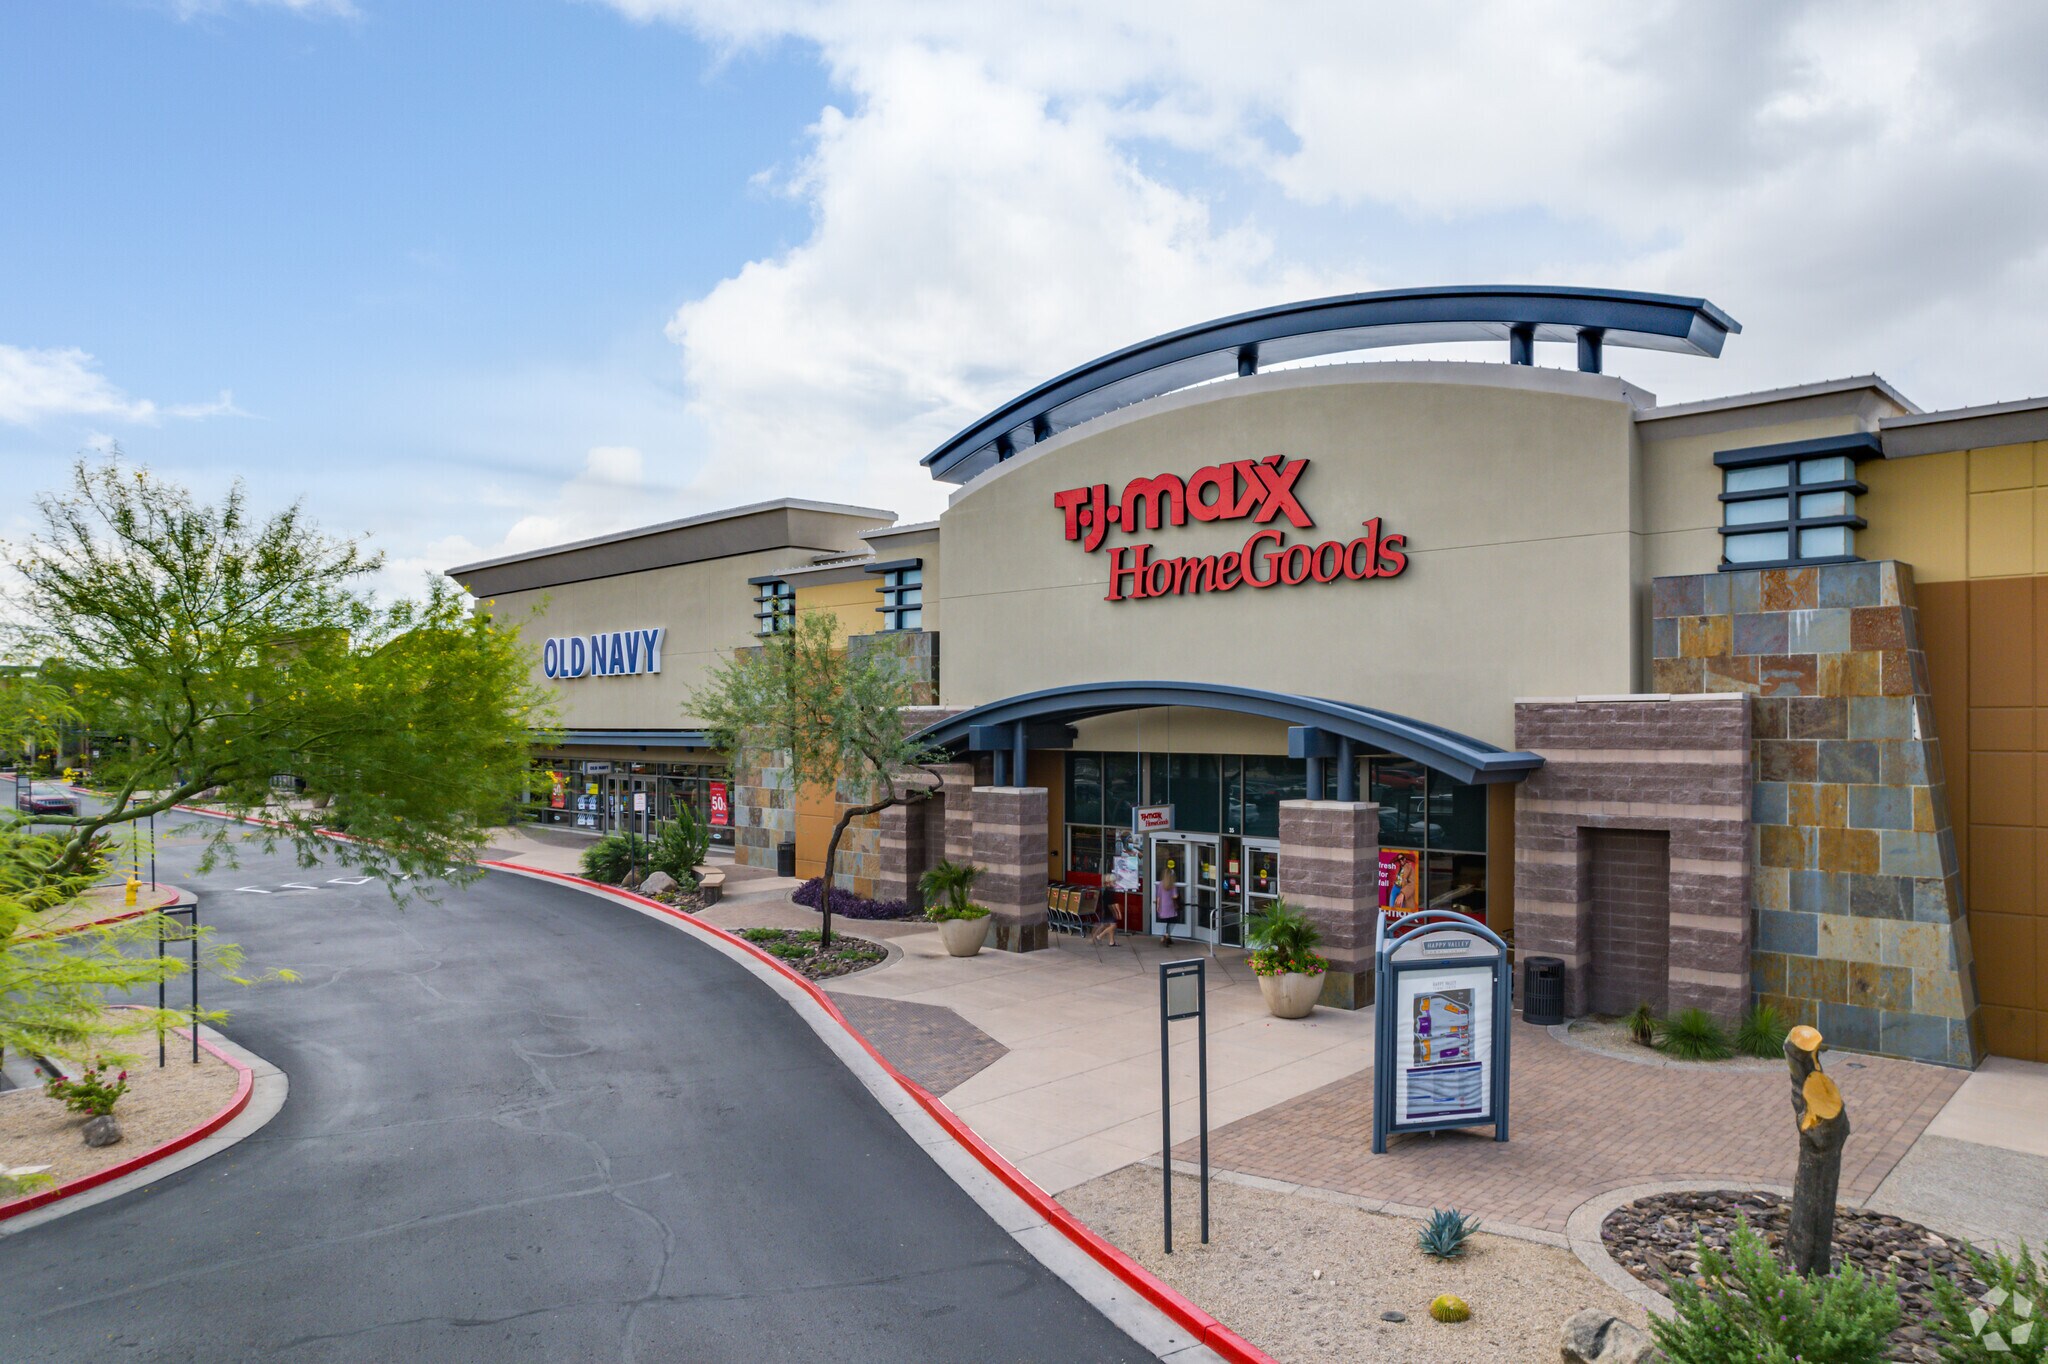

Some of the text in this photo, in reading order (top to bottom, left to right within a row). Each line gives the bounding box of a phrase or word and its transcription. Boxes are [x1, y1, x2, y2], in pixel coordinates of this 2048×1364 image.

[1104, 516, 1407, 602] HomeGoods
[543, 627, 666, 679] OLD NAVY
[1146, 818, 1168, 827] HomeGoods
